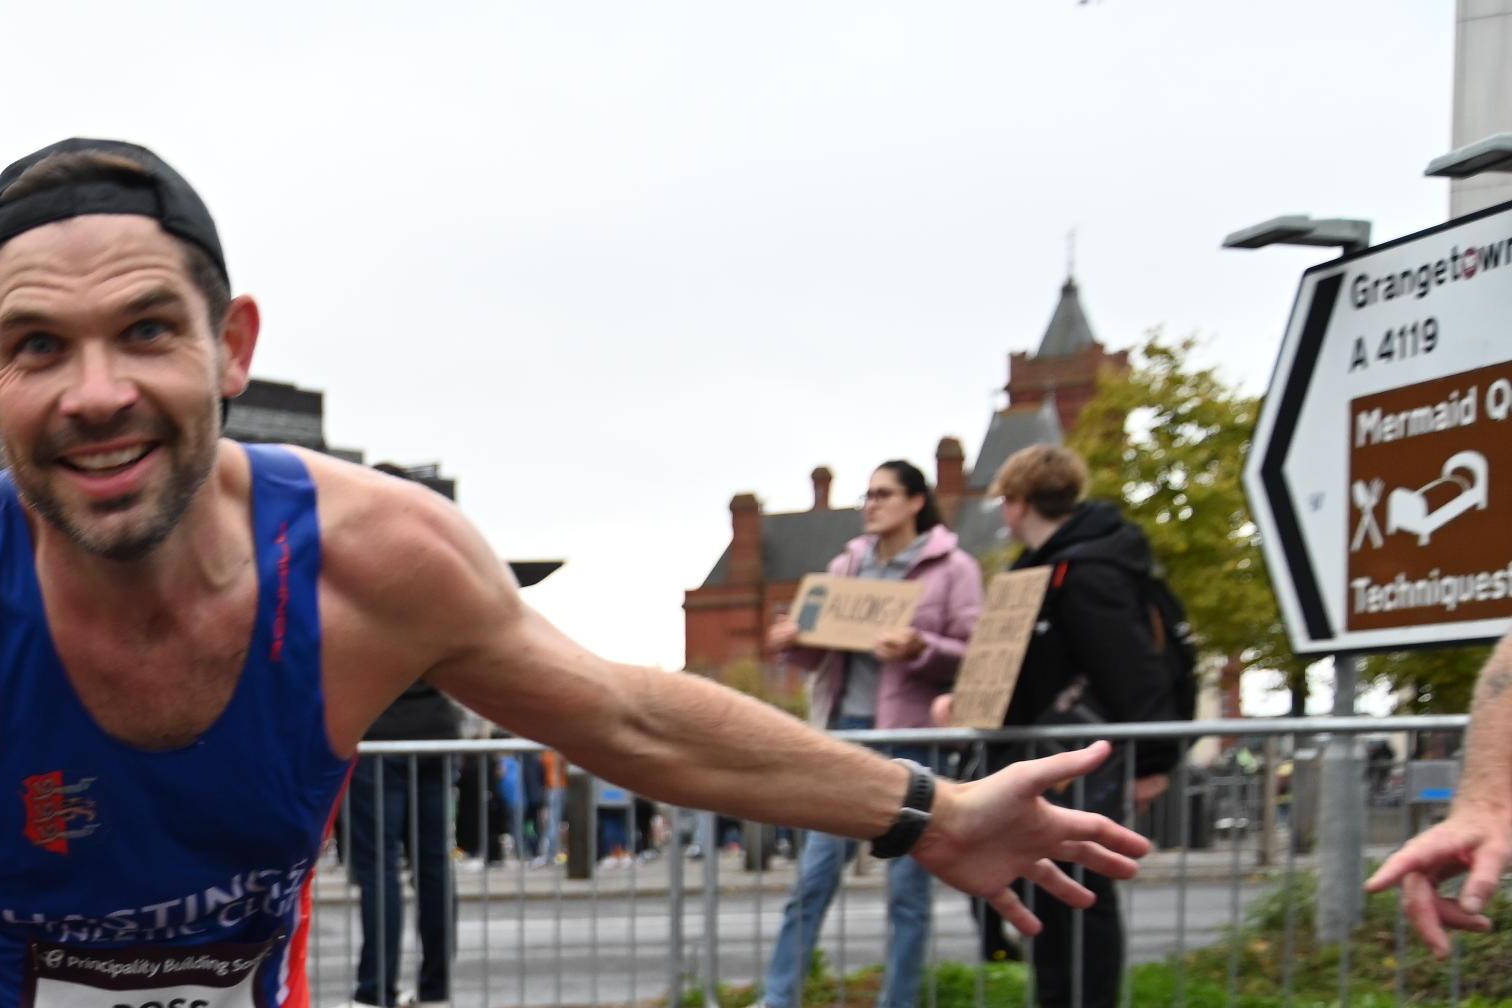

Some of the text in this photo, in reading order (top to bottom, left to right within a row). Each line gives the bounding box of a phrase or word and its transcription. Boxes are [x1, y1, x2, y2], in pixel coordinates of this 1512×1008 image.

[1348, 316, 1438, 373] A 4119
[1355, 378, 1512, 448] Mermaid Q
[66, 955, 162, 978] Principality
[163, 954, 230, 976] Building
